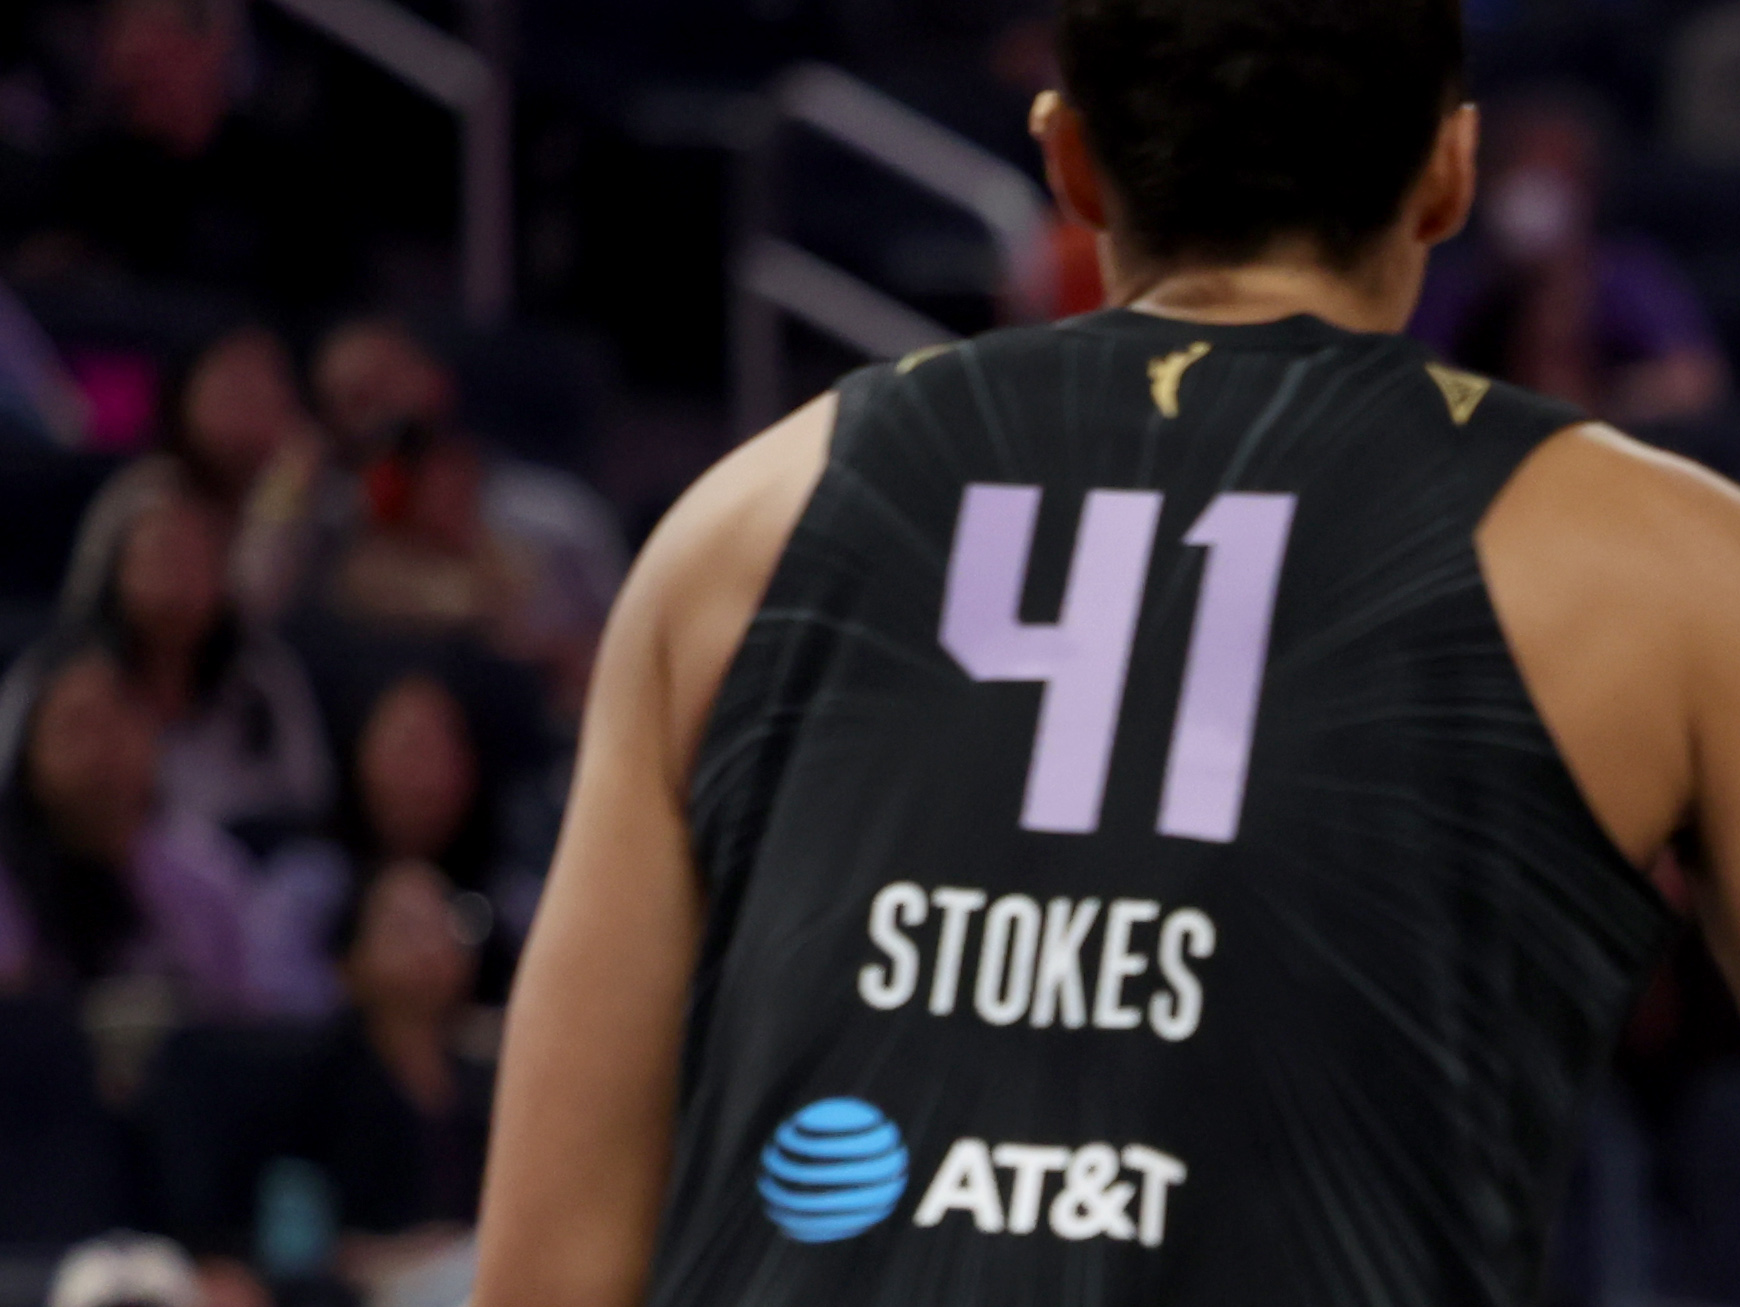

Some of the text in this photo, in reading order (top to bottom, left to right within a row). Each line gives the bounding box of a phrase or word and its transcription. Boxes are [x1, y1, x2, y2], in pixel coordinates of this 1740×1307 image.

[938, 482, 1298, 843] 41
[857, 882, 1217, 1042] STOKES
[912, 1137, 1187, 1249] AT&T
